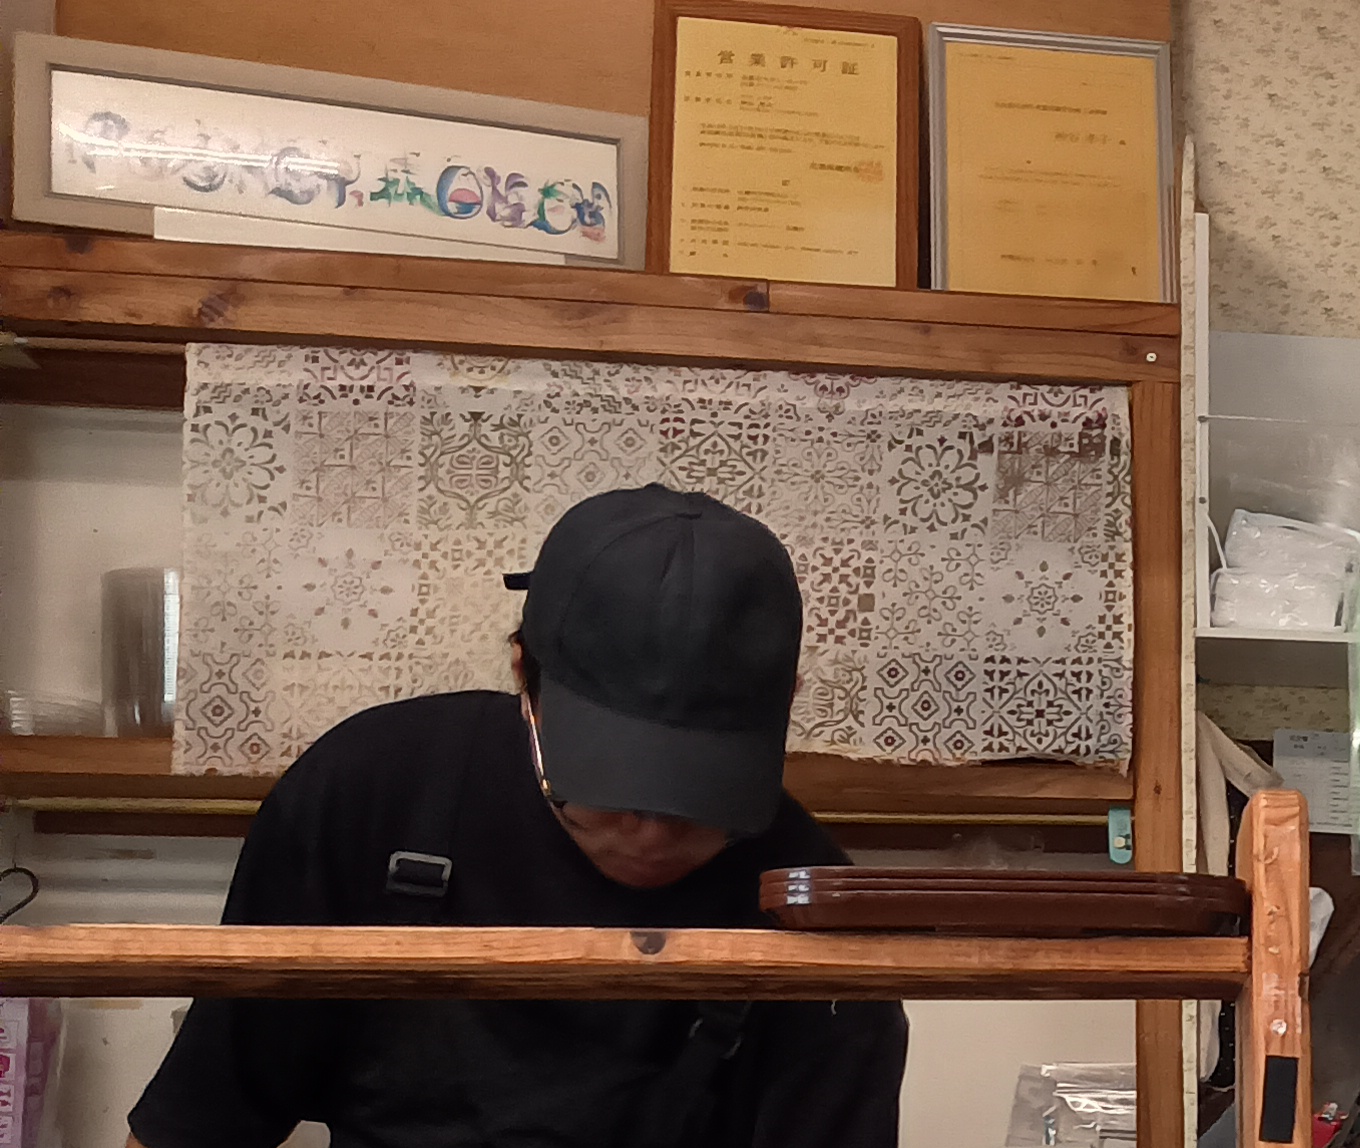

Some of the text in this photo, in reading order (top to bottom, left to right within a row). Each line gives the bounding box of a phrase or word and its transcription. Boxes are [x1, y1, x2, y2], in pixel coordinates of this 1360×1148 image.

[717, 49, 859, 76] 営業許可証
